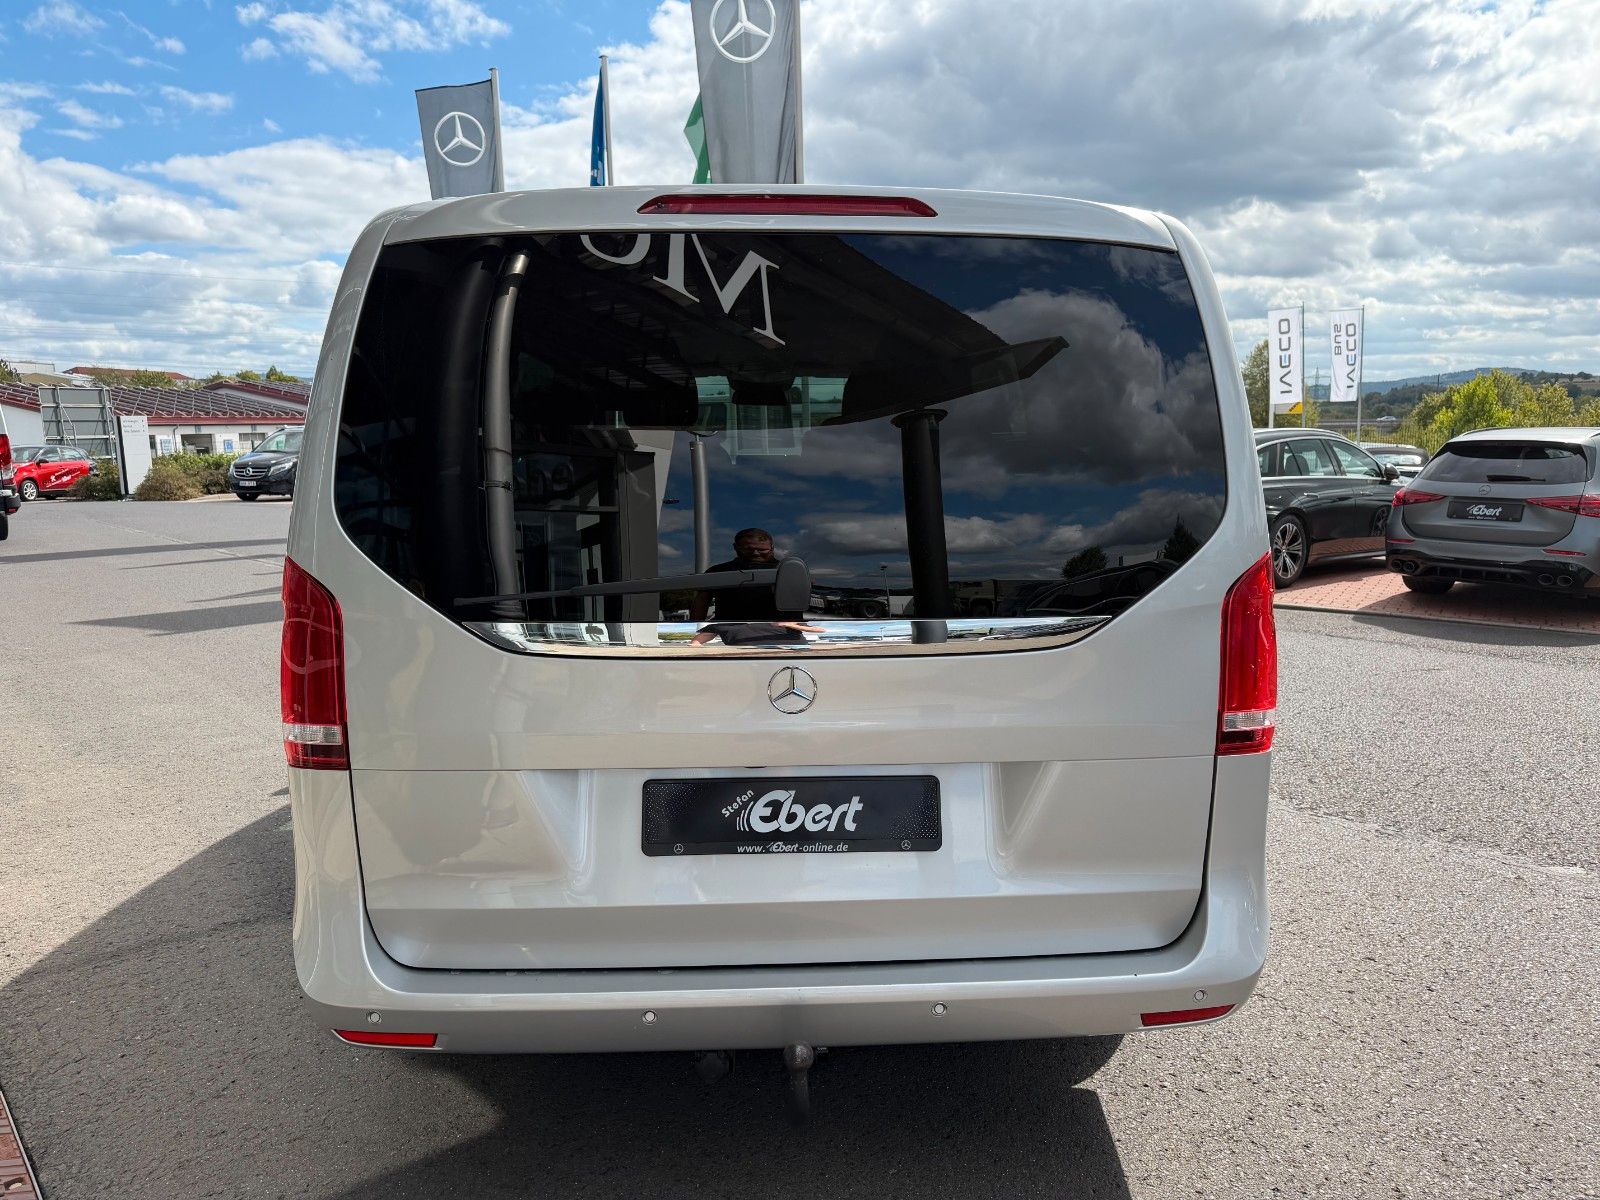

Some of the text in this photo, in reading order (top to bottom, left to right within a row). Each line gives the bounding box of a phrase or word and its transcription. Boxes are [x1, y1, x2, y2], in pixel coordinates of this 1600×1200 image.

[1333, 323, 1342, 356] BUS
[1345, 322, 1357, 389] IVECO
[1278, 318, 1292, 395] IVECO
[1472, 504, 1503, 516] Ebert
[721, 789, 755, 818] Stefan
[749, 789, 864, 833] Ebert
[736, 841, 849, 853] www.Ebert-online.de
